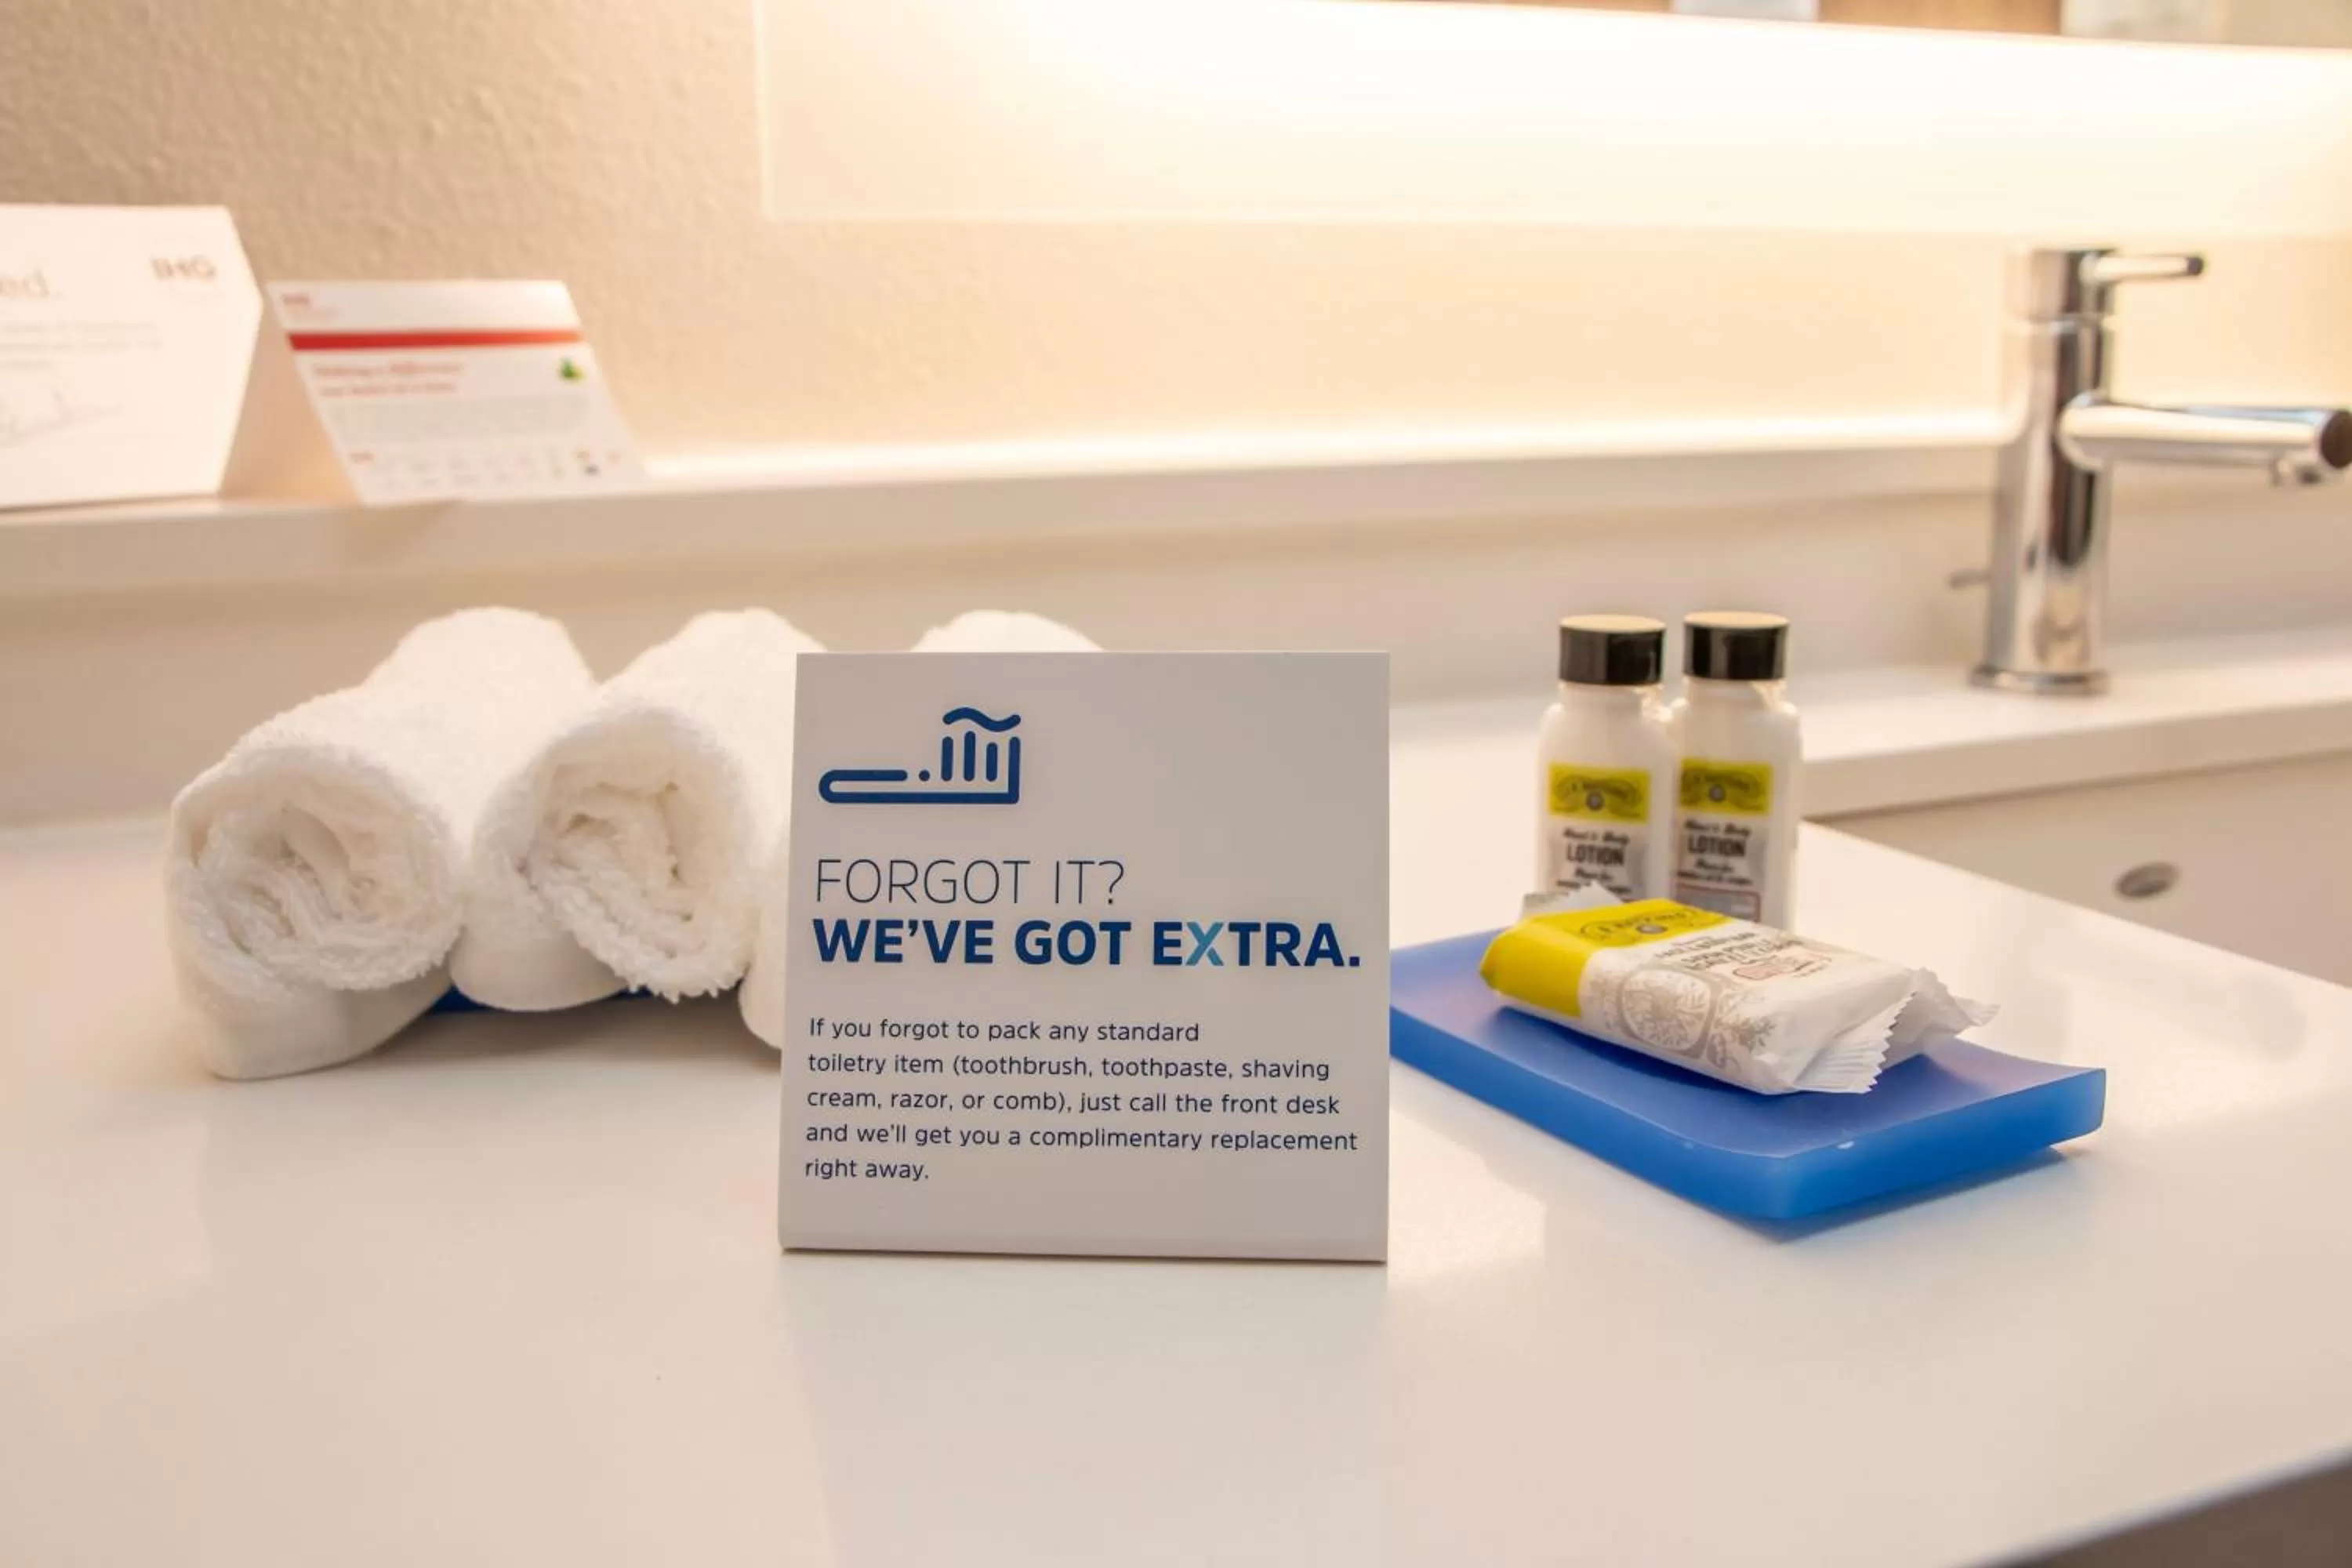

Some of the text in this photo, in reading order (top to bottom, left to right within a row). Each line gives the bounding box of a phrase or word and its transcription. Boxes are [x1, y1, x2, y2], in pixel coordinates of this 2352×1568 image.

[816, 858, 1125, 906] FORGOT IT?
[811, 917, 1361, 968] WE'VE GOT EXTRA.
[810, 1017, 1200, 1044] If you forgot to pack any standard
[808, 1053, 1330, 1082] toiletry item (toothbrush, toothpaste, shaving
[807, 1091, 1340, 1115] cream, razor, or comb), just call the front desk
[805, 1123, 1359, 1152] and we'll get you a complimentary replacement
[804, 1157, 929, 1182] right away.
